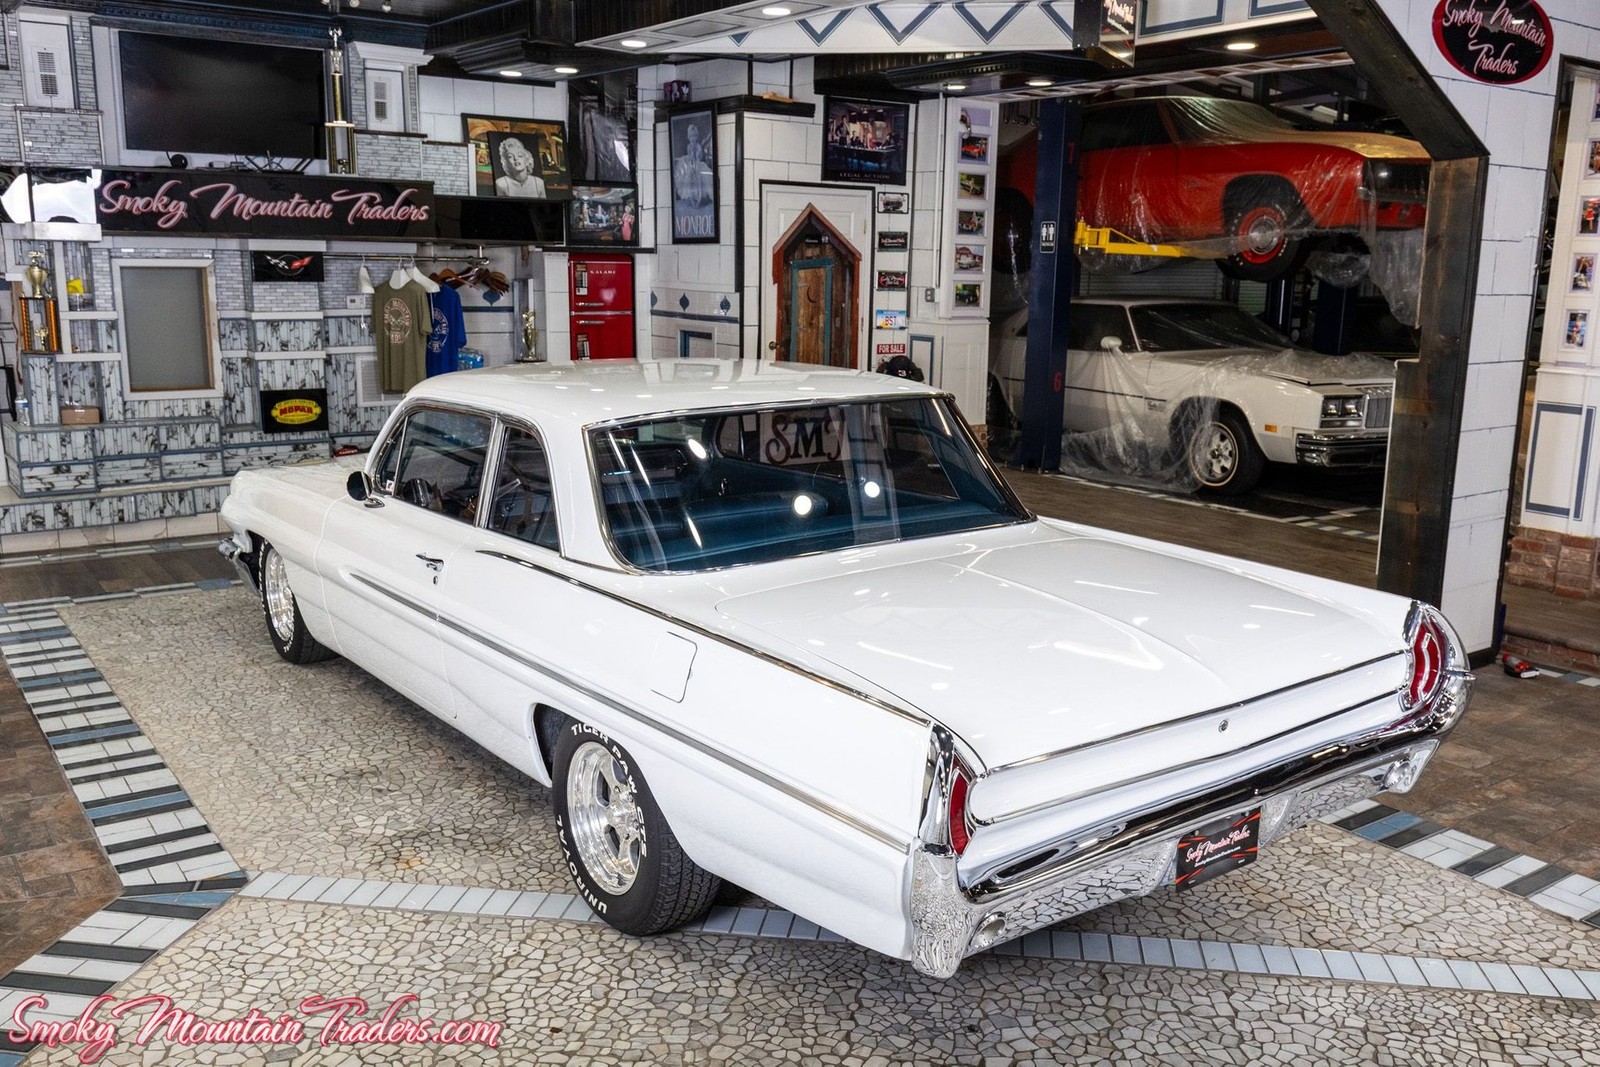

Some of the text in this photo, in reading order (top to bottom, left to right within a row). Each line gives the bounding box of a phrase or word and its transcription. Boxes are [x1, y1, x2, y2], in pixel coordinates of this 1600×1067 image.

[1443, 0, 1546, 47] Smoky Mountain
[1467, 39, 1519, 75] Traders
[100, 179, 430, 229] Smoky Mountain Traders
[675, 214, 714, 236] MONROE
[878, 344, 905, 354] FOR SALE
[278, 404, 314, 417] MOPAR
[571, 722, 610, 743] TIGER
[611, 745, 638, 795] PAW
[554, 813, 608, 915] UNIROYAL
